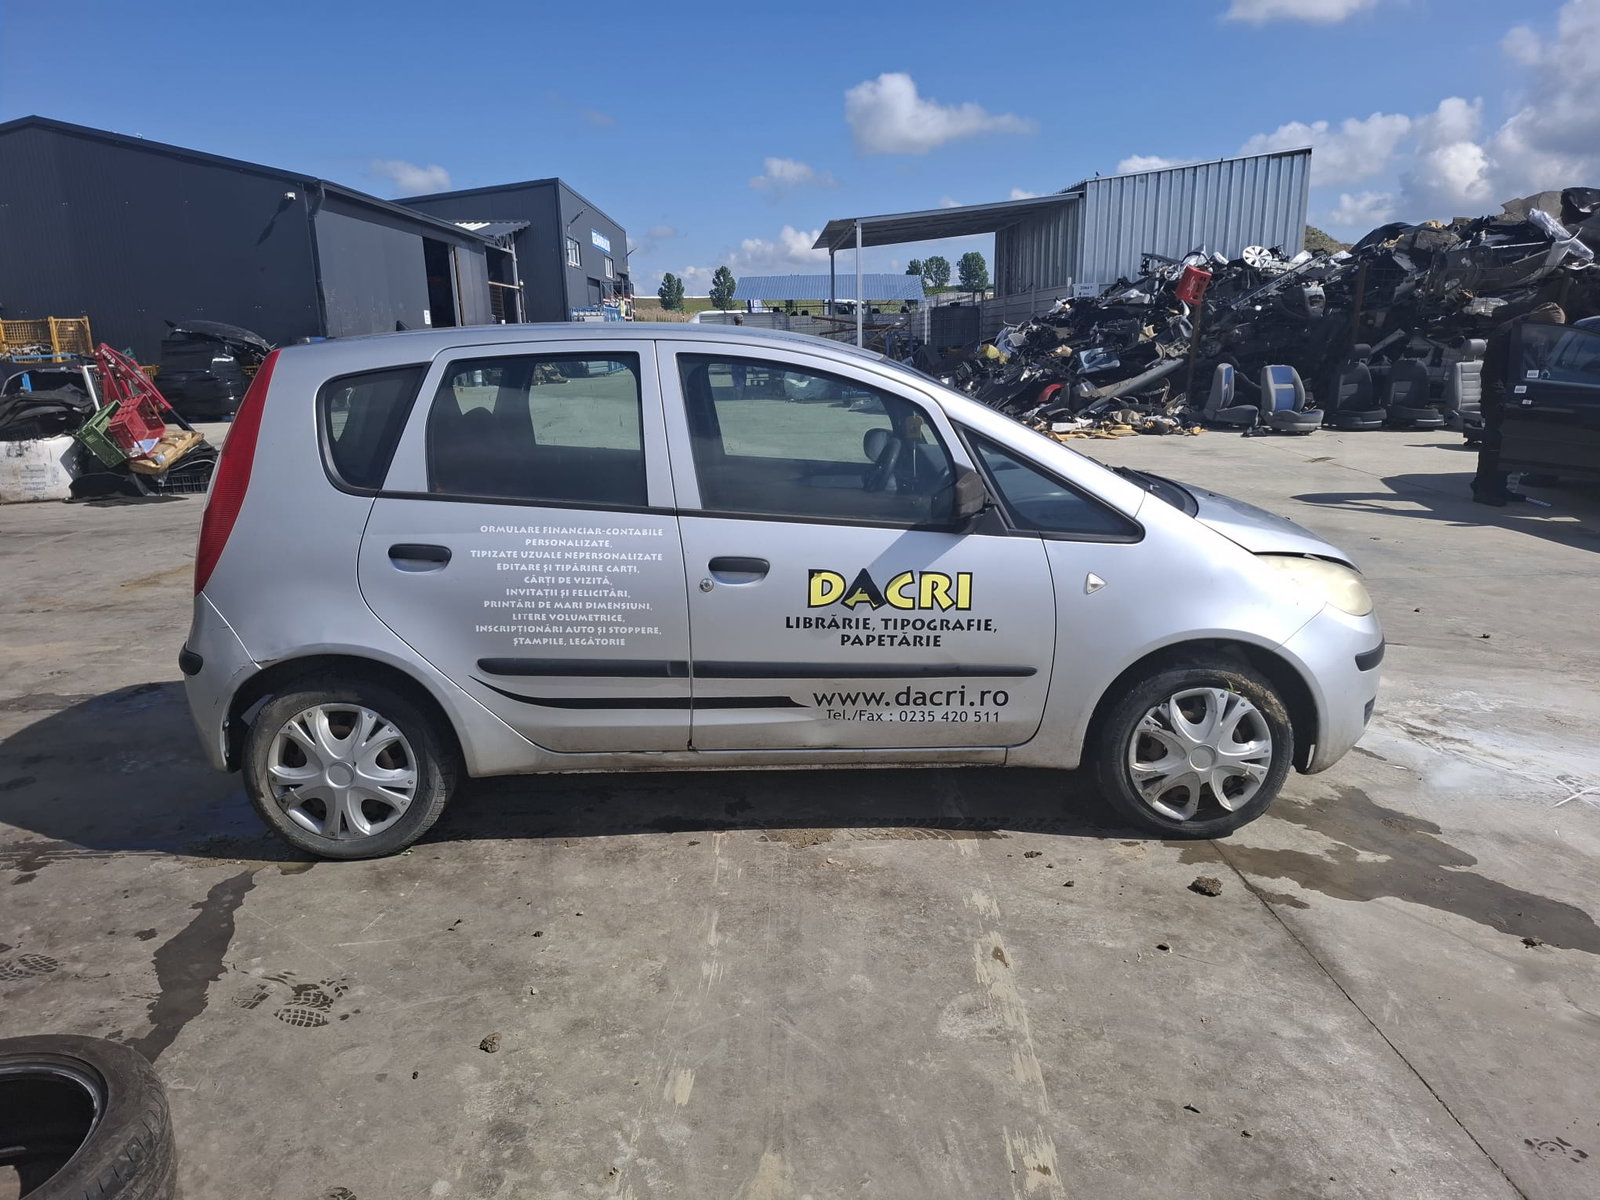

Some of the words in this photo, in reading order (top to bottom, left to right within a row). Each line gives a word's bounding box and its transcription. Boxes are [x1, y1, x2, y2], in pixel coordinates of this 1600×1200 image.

[542, 526, 664, 536] FINANCIAR-CONTABILE
[470, 550, 518, 558] TIPIZATE
[520, 551, 562, 560] UZUALE
[564, 551, 663, 561] NEPERSONALIZATE
[496, 563, 541, 571] EDITARE
[558, 576, 571, 585] DE
[807, 567, 974, 613] DACRI
[537, 601, 552, 609] DE
[553, 601, 583, 609] MARI
[585, 602, 653, 611] DIMENSIUNI,
[512, 613, 547, 621] LITERE
[548, 613, 626, 622] VOLUMETRICE,
[785, 614, 876, 632] LIBRĂRIE,
[880, 617, 998, 633] TIPOGRAFIE,
[565, 626, 595, 634] AUTO
[608, 626, 662, 635] STOPPERE,
[840, 632, 942, 648] PAPETĂRIE
[812, 685, 1010, 708] www.dacri.ro
[899, 710, 935, 722] 0235
[940, 711, 968, 723] 420
[973, 711, 1000, 723] 511
